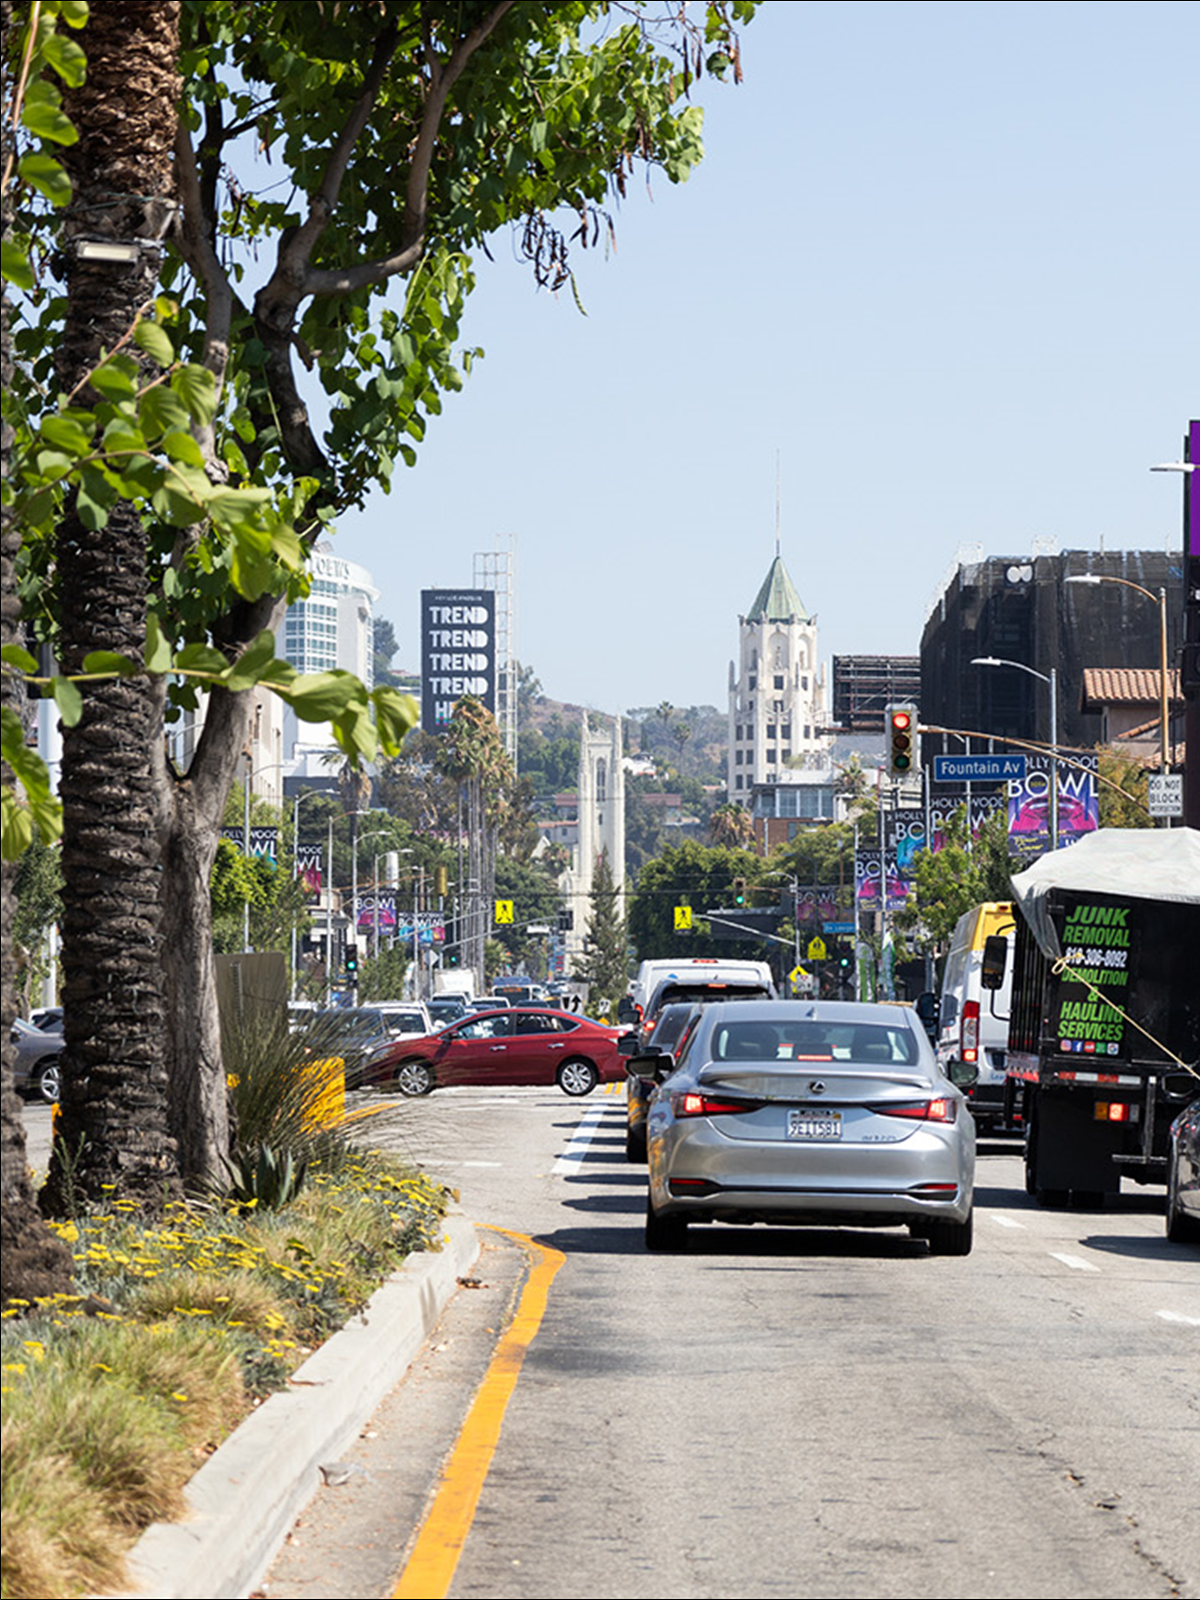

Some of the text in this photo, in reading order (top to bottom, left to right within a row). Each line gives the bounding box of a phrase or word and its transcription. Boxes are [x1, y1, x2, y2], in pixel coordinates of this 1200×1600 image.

[429, 606, 489, 624] TREND
[429, 630, 489, 648] TREND
[429, 653, 489, 671] TREND
[429, 677, 489, 695] TREND
[941, 761, 1020, 775] Fountain Av
[1150, 793, 1181, 803] BLOCK
[1066, 906, 1131, 927] JUNK
[1062, 925, 1131, 947] REMOVAL
[1062, 968, 1129, 986] DEMOLITION
[1087, 986, 1099, 1002] &
[1060, 1002, 1125, 1024] HAULING
[1057, 1021, 1125, 1042] SERVICES
